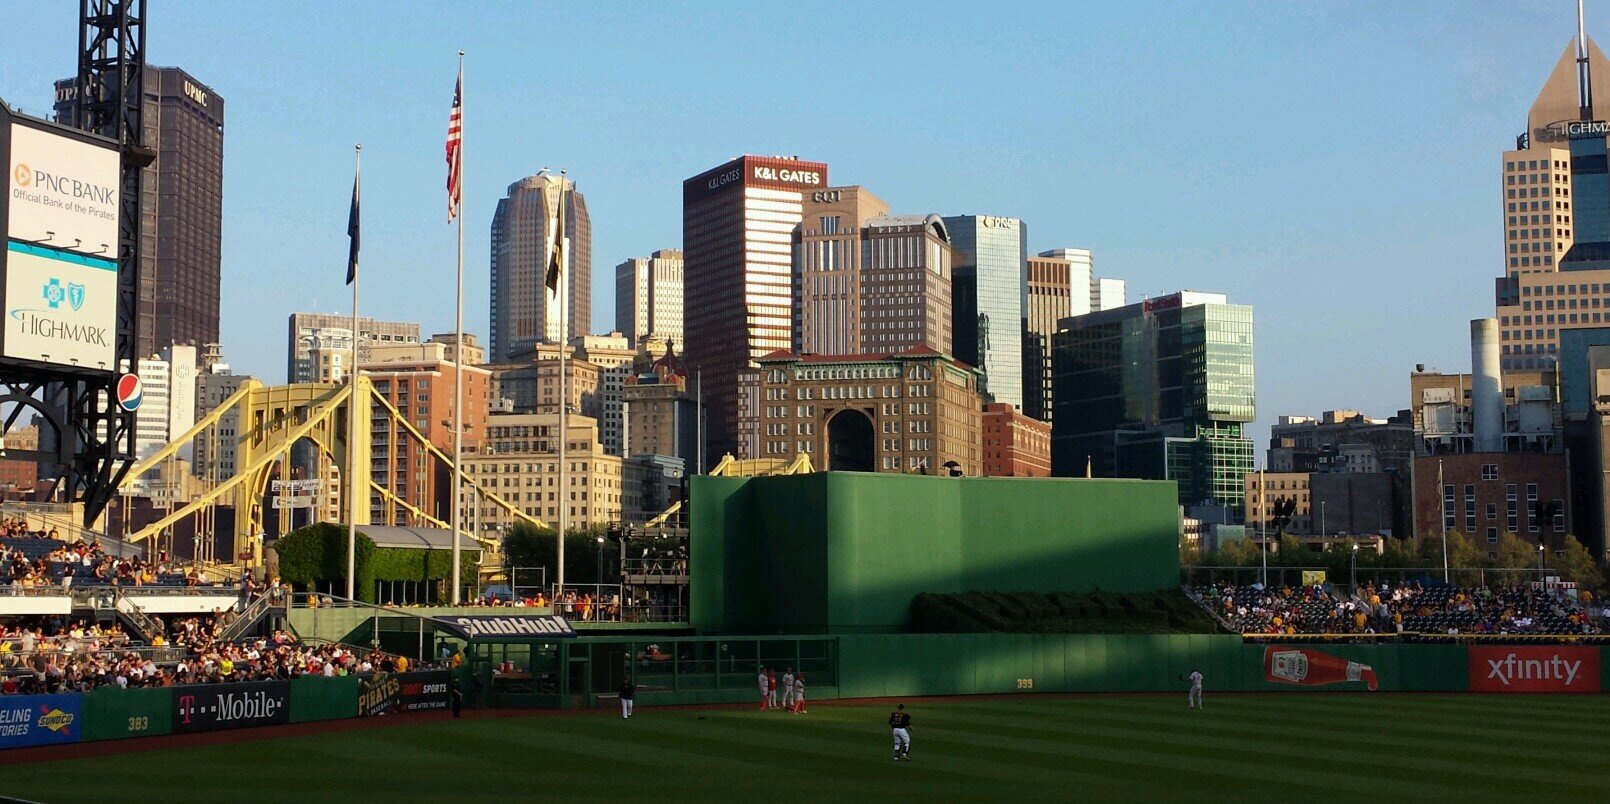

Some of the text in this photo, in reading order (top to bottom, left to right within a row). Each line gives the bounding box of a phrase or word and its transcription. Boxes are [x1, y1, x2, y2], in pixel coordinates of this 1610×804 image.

[184, 80, 207, 107] UPMC
[708, 168, 740, 191] K&L GATES
[754, 166, 820, 185] K&L GATES
[34, 170, 115, 206] PNC BANK
[13, 188, 115, 220] Official Bank of the Pirates
[22, 312, 107, 348] HIGHMARK
[457, 616, 571, 635] StubHub!
[1487, 653, 1581, 685] xfinity
[422, 683, 447, 694] SPORTS
[1017, 678, 1033, 689] 399
[358, 678, 400, 716] PIRATES
[0, 708, 32, 724] ELING
[39, 714, 73, 726] SUNOCO
[128, 716, 148, 731] 383
